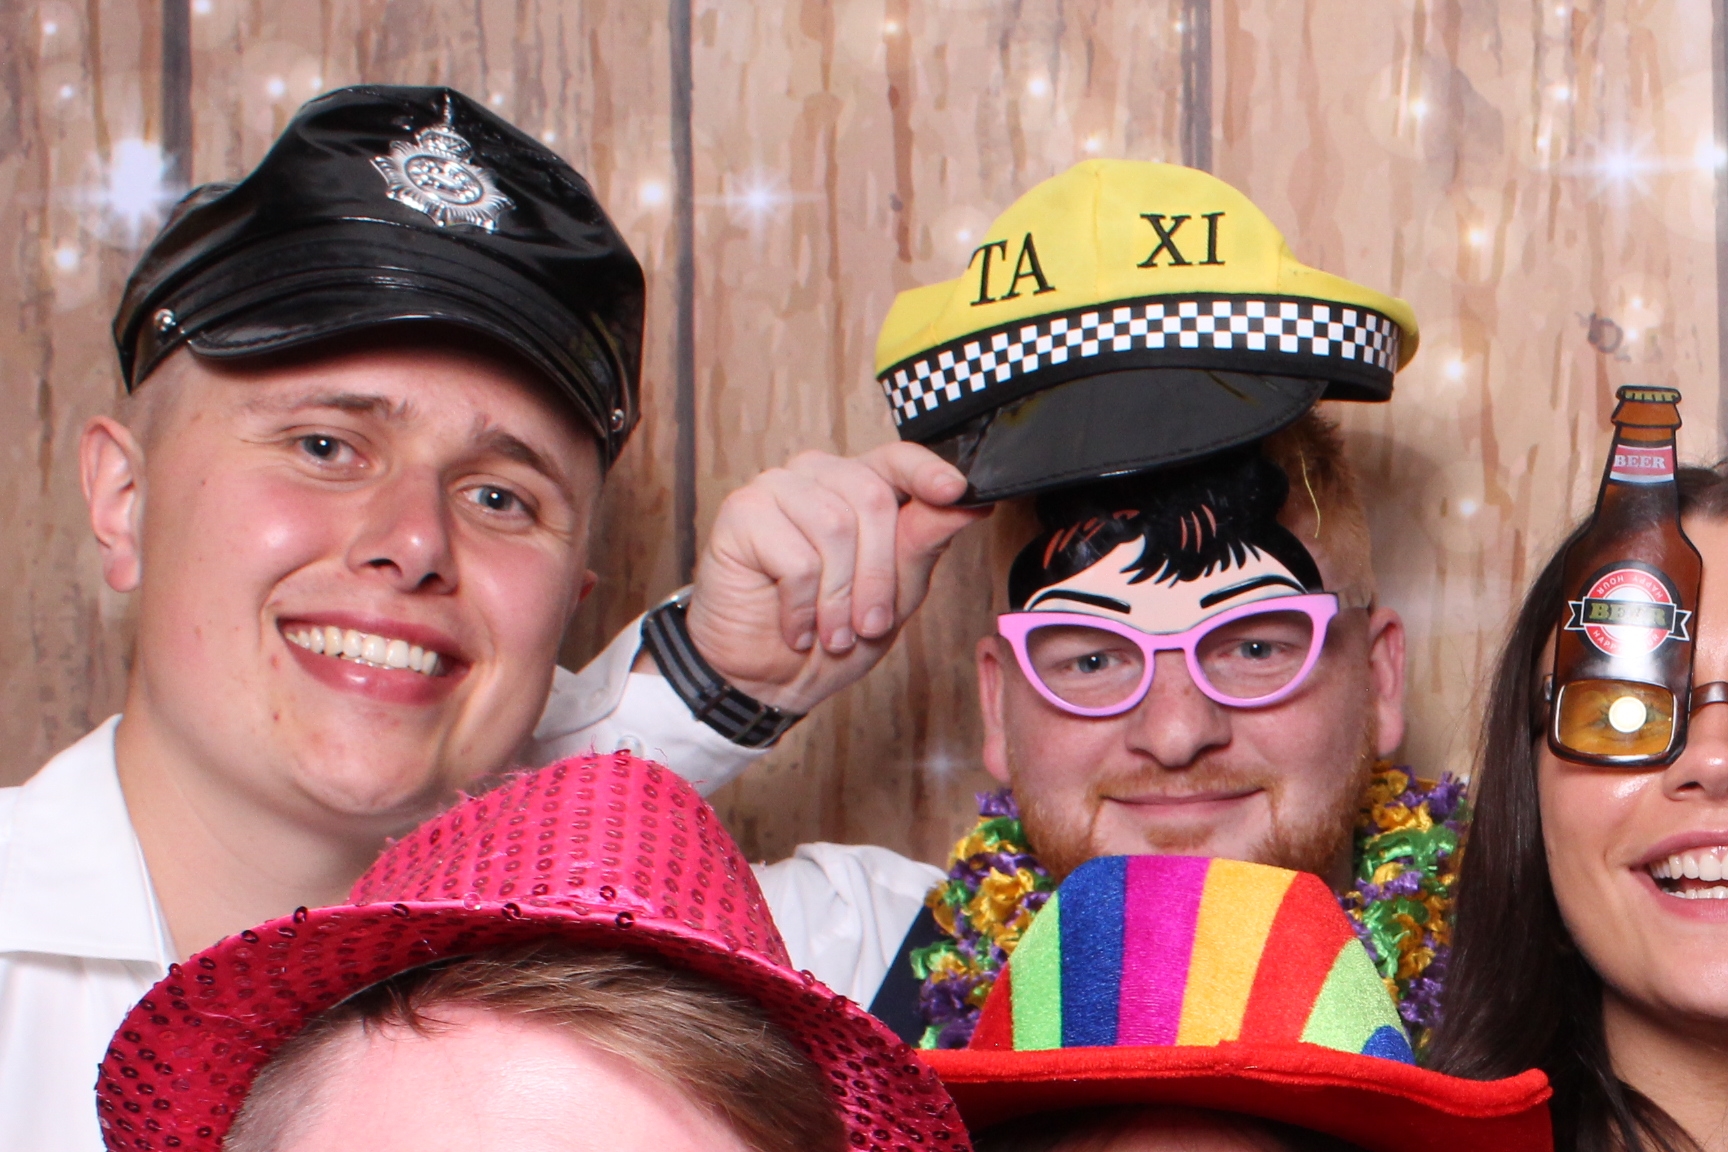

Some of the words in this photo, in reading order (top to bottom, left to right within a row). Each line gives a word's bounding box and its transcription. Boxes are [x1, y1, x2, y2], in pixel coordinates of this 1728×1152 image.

[967, 231, 1056, 307] TA
[1136, 211, 1226, 269] XI
[1613, 454, 1665, 469] BEER
[1596, 574, 1624, 595] HOUR
[1633, 575, 1664, 599] HAPPY
[1593, 629, 1621, 650] HAPP
